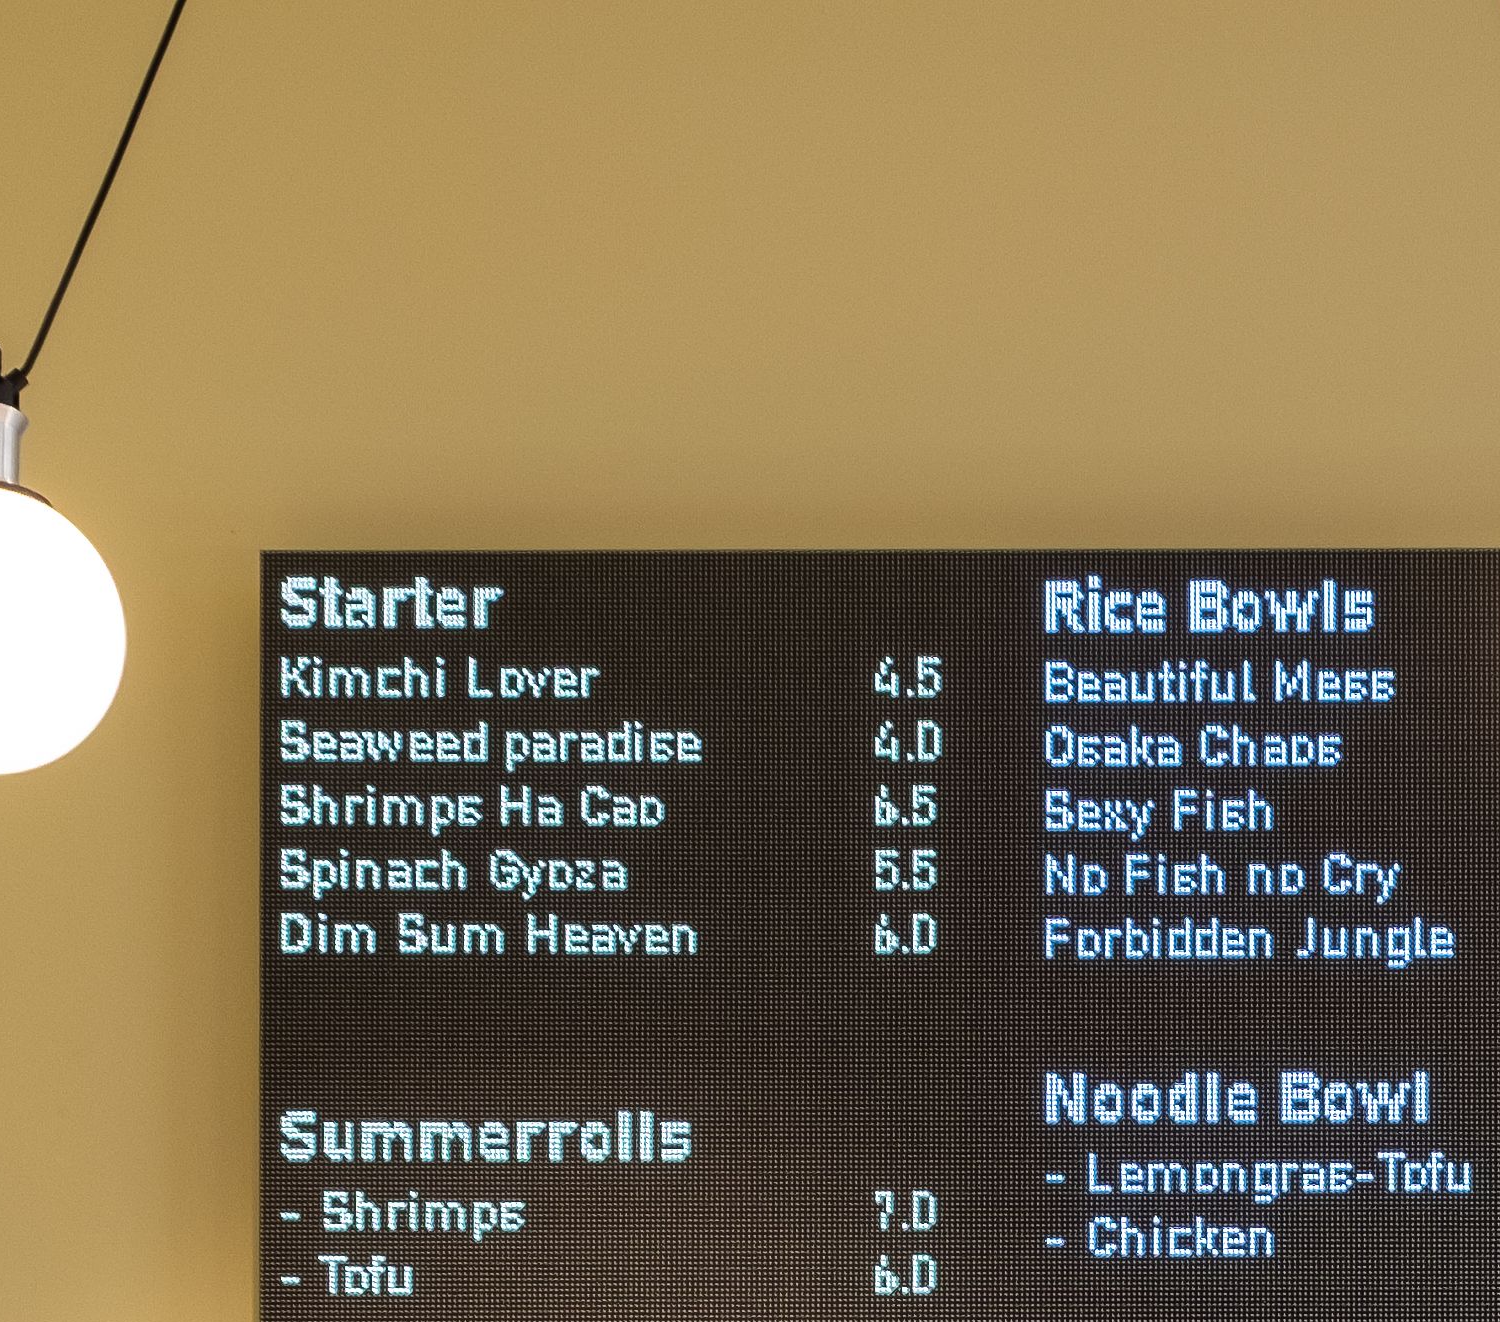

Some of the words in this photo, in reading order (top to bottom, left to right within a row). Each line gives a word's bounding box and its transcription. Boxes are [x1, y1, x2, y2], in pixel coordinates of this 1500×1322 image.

[281, 576, 503, 628] Starter
[1044, 575, 1166, 634] Rice
[1188, 579, 1374, 633] Bowls
[281, 657, 445, 698] Kimchi
[468, 657, 599, 698] Lover
[874, 656, 941, 697] 4.5
[1045, 660, 1256, 703] Beautiful
[1275, 660, 1395, 702] Mess
[281, 720, 488, 762] Seaweed
[506, 721, 702, 772] paradise
[874, 720, 941, 761] 4.0
[1045, 725, 1182, 767] Osaka
[1199, 724, 1342, 767] Chaos
[281, 784, 482, 836] Shrimps
[500, 785, 562, 826] Ha
[581, 785, 664, 826] Cao
[875, 785, 936, 826] 6.5
[1045, 789, 1155, 842] Sexy
[1173, 789, 1273, 831] Fish
[281, 849, 466, 899] Spinach
[490, 849, 626, 900] Gyoza
[875, 849, 936, 890] 5.5
[1045, 854, 1108, 895] No
[1125, 853, 1225, 895] Fish
[1248, 863, 1305, 895] no
[1323, 853, 1401, 904] Cry
[281, 913, 375, 953] Dim
[399, 913, 504, 953] Sum
[527, 913, 696, 954] Heaven
[875, 913, 936, 954] 6.0
[1045, 917, 1273, 959] Forbidden
[1297, 917, 1454, 969] Jungle
[1045, 1072, 1257, 1124] Noodle
[1280, 1071, 1429, 1124] Bowl
[281, 1110, 691, 1162] Summerrolls
[1088, 1151, 1471, 1204] Lemongras-Tofu
[323, 1191, 525, 1241] Shrimps
[875, 1190, 936, 1230] 7.0
[1088, 1216, 1274, 1257] Chicken
[318, 1255, 412, 1295] Tofu
[874, 1254, 936, 1294] 6.0
